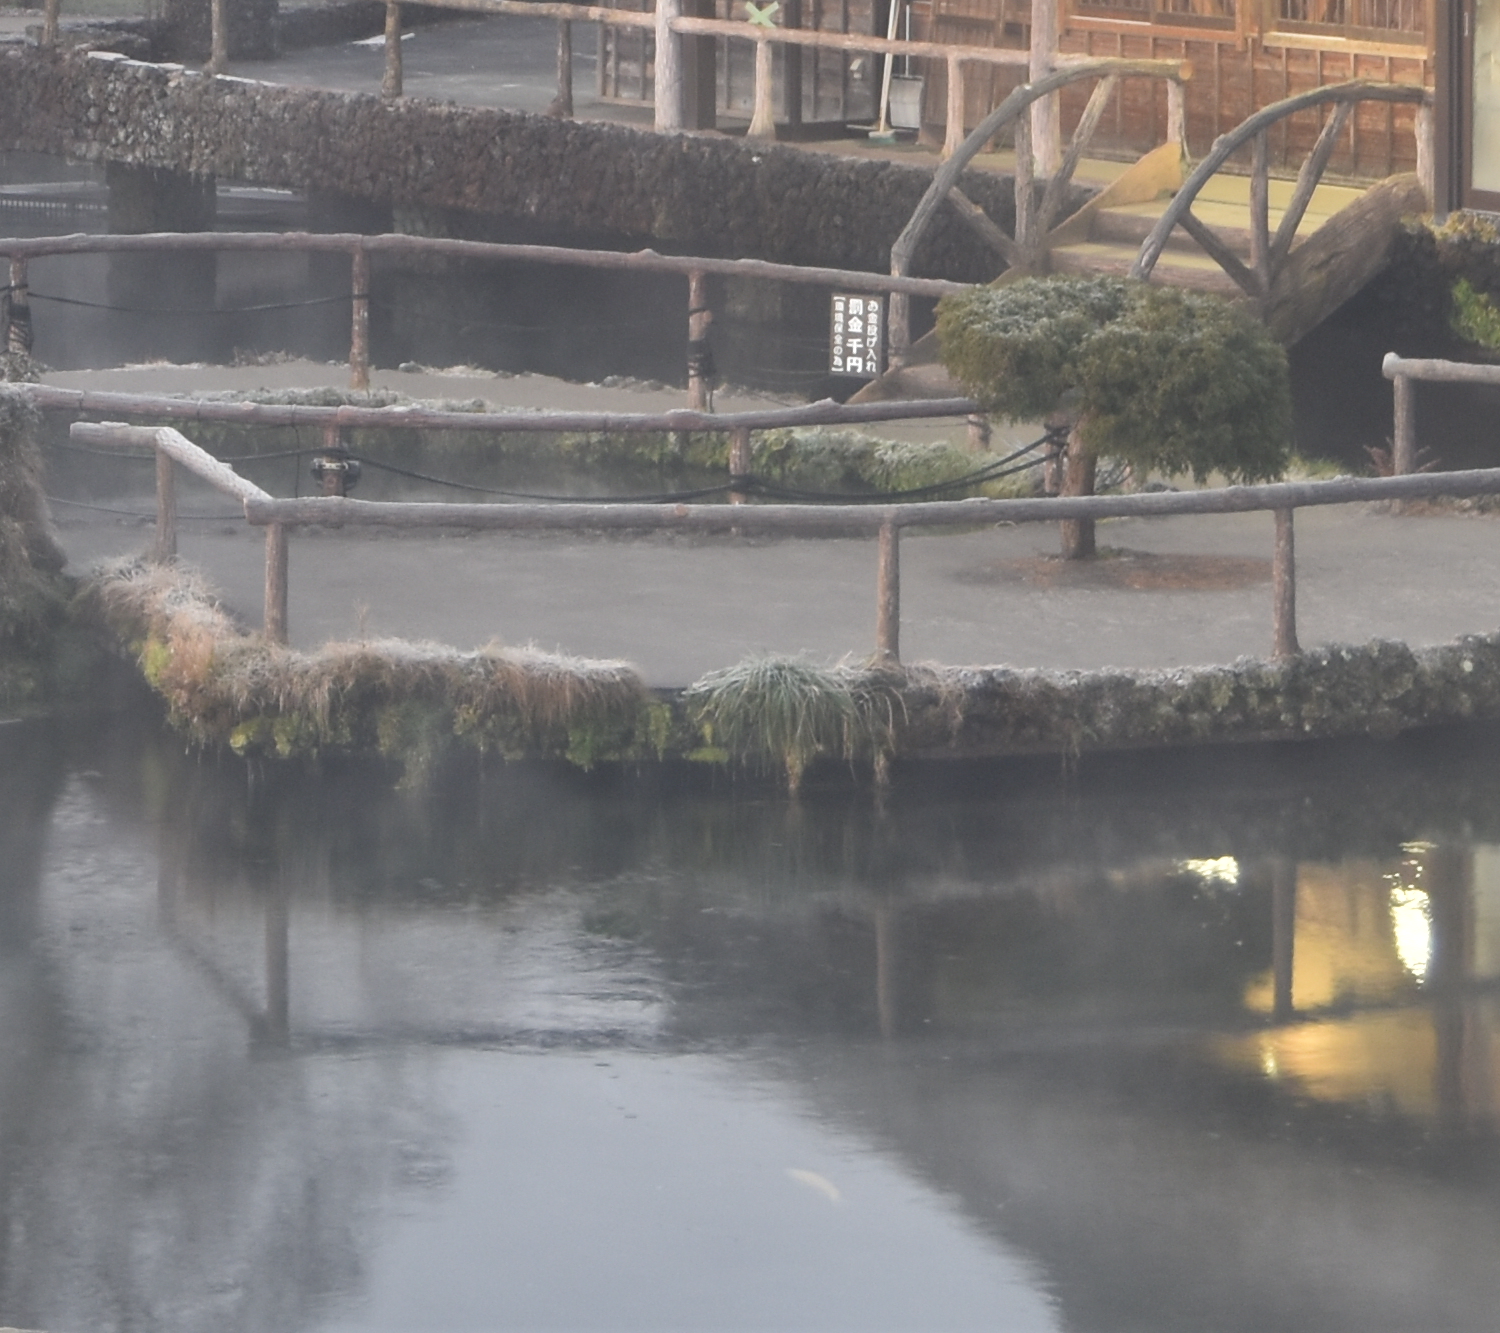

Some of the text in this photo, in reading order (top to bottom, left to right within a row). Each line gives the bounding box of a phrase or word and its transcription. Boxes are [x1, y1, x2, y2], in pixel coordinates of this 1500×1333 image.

[866, 300, 878, 373] お金投げ入れ
